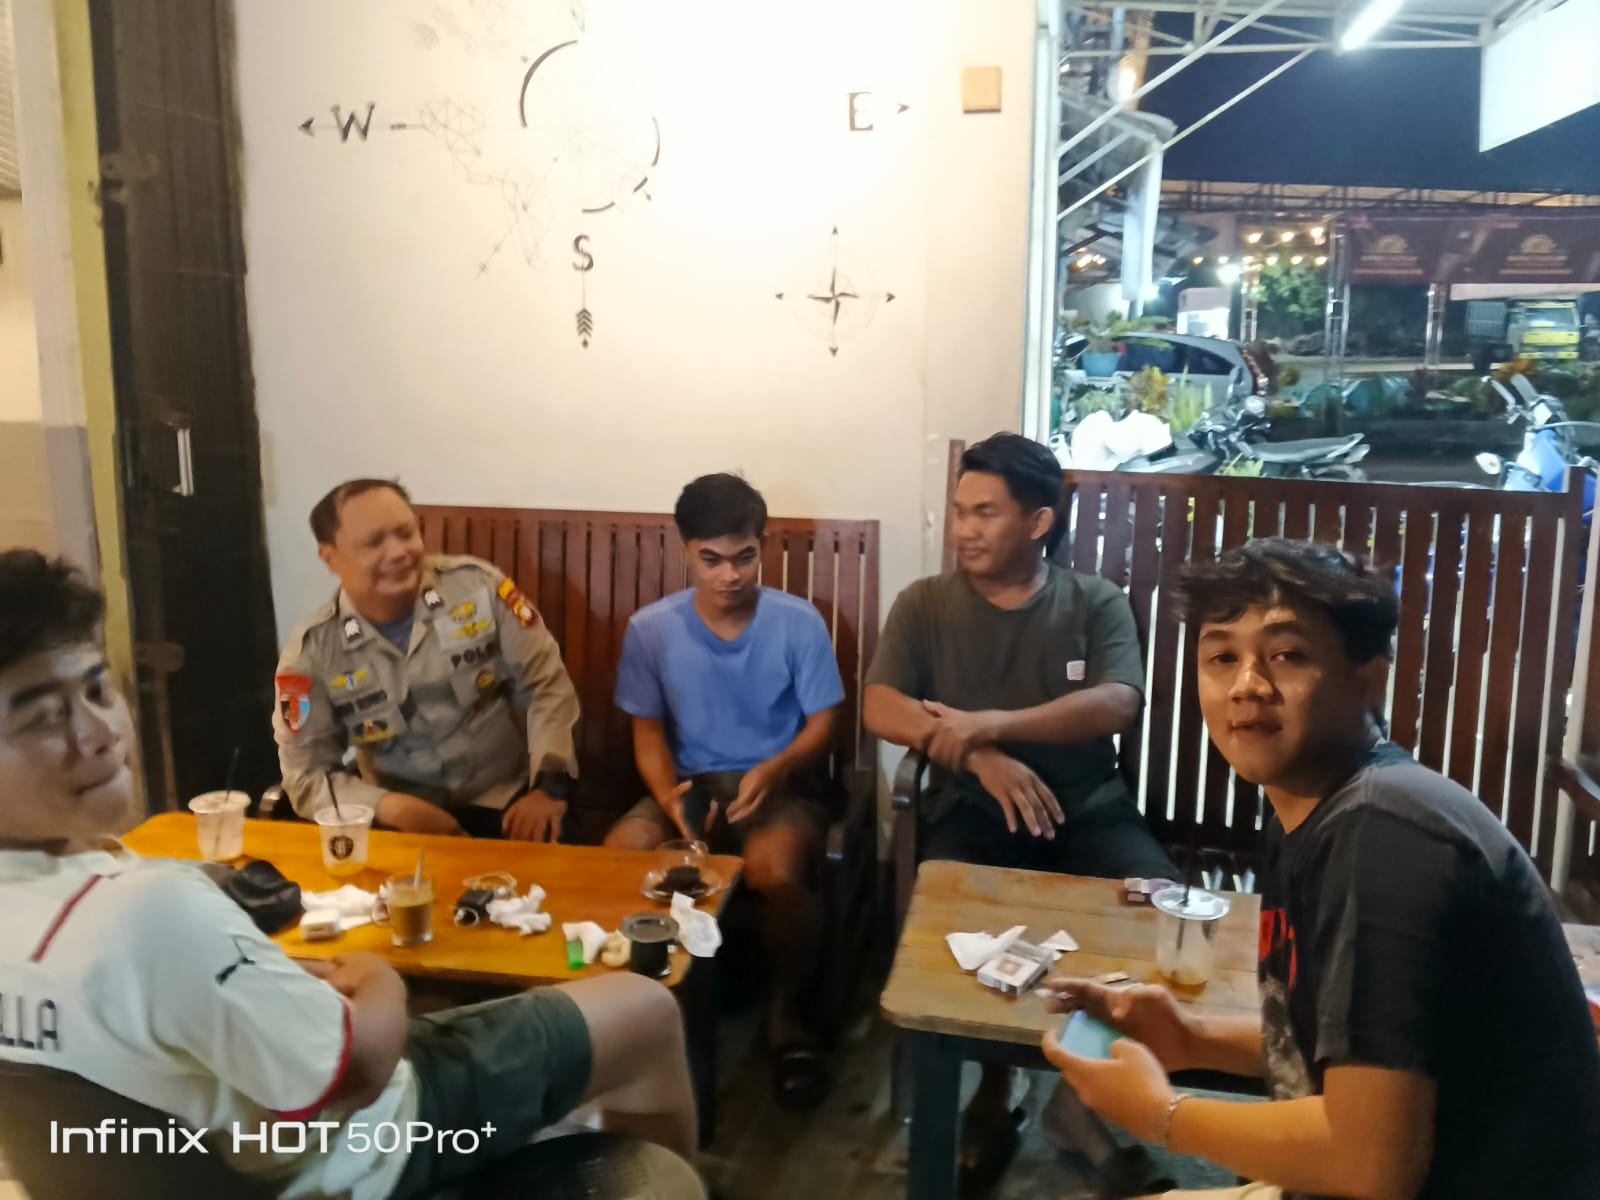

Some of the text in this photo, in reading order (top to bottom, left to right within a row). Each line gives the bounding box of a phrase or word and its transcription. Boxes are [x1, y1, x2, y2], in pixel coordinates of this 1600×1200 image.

[329, 102, 376, 142] W
[848, 90, 874, 132] E
[572, 234, 594, 272] S
